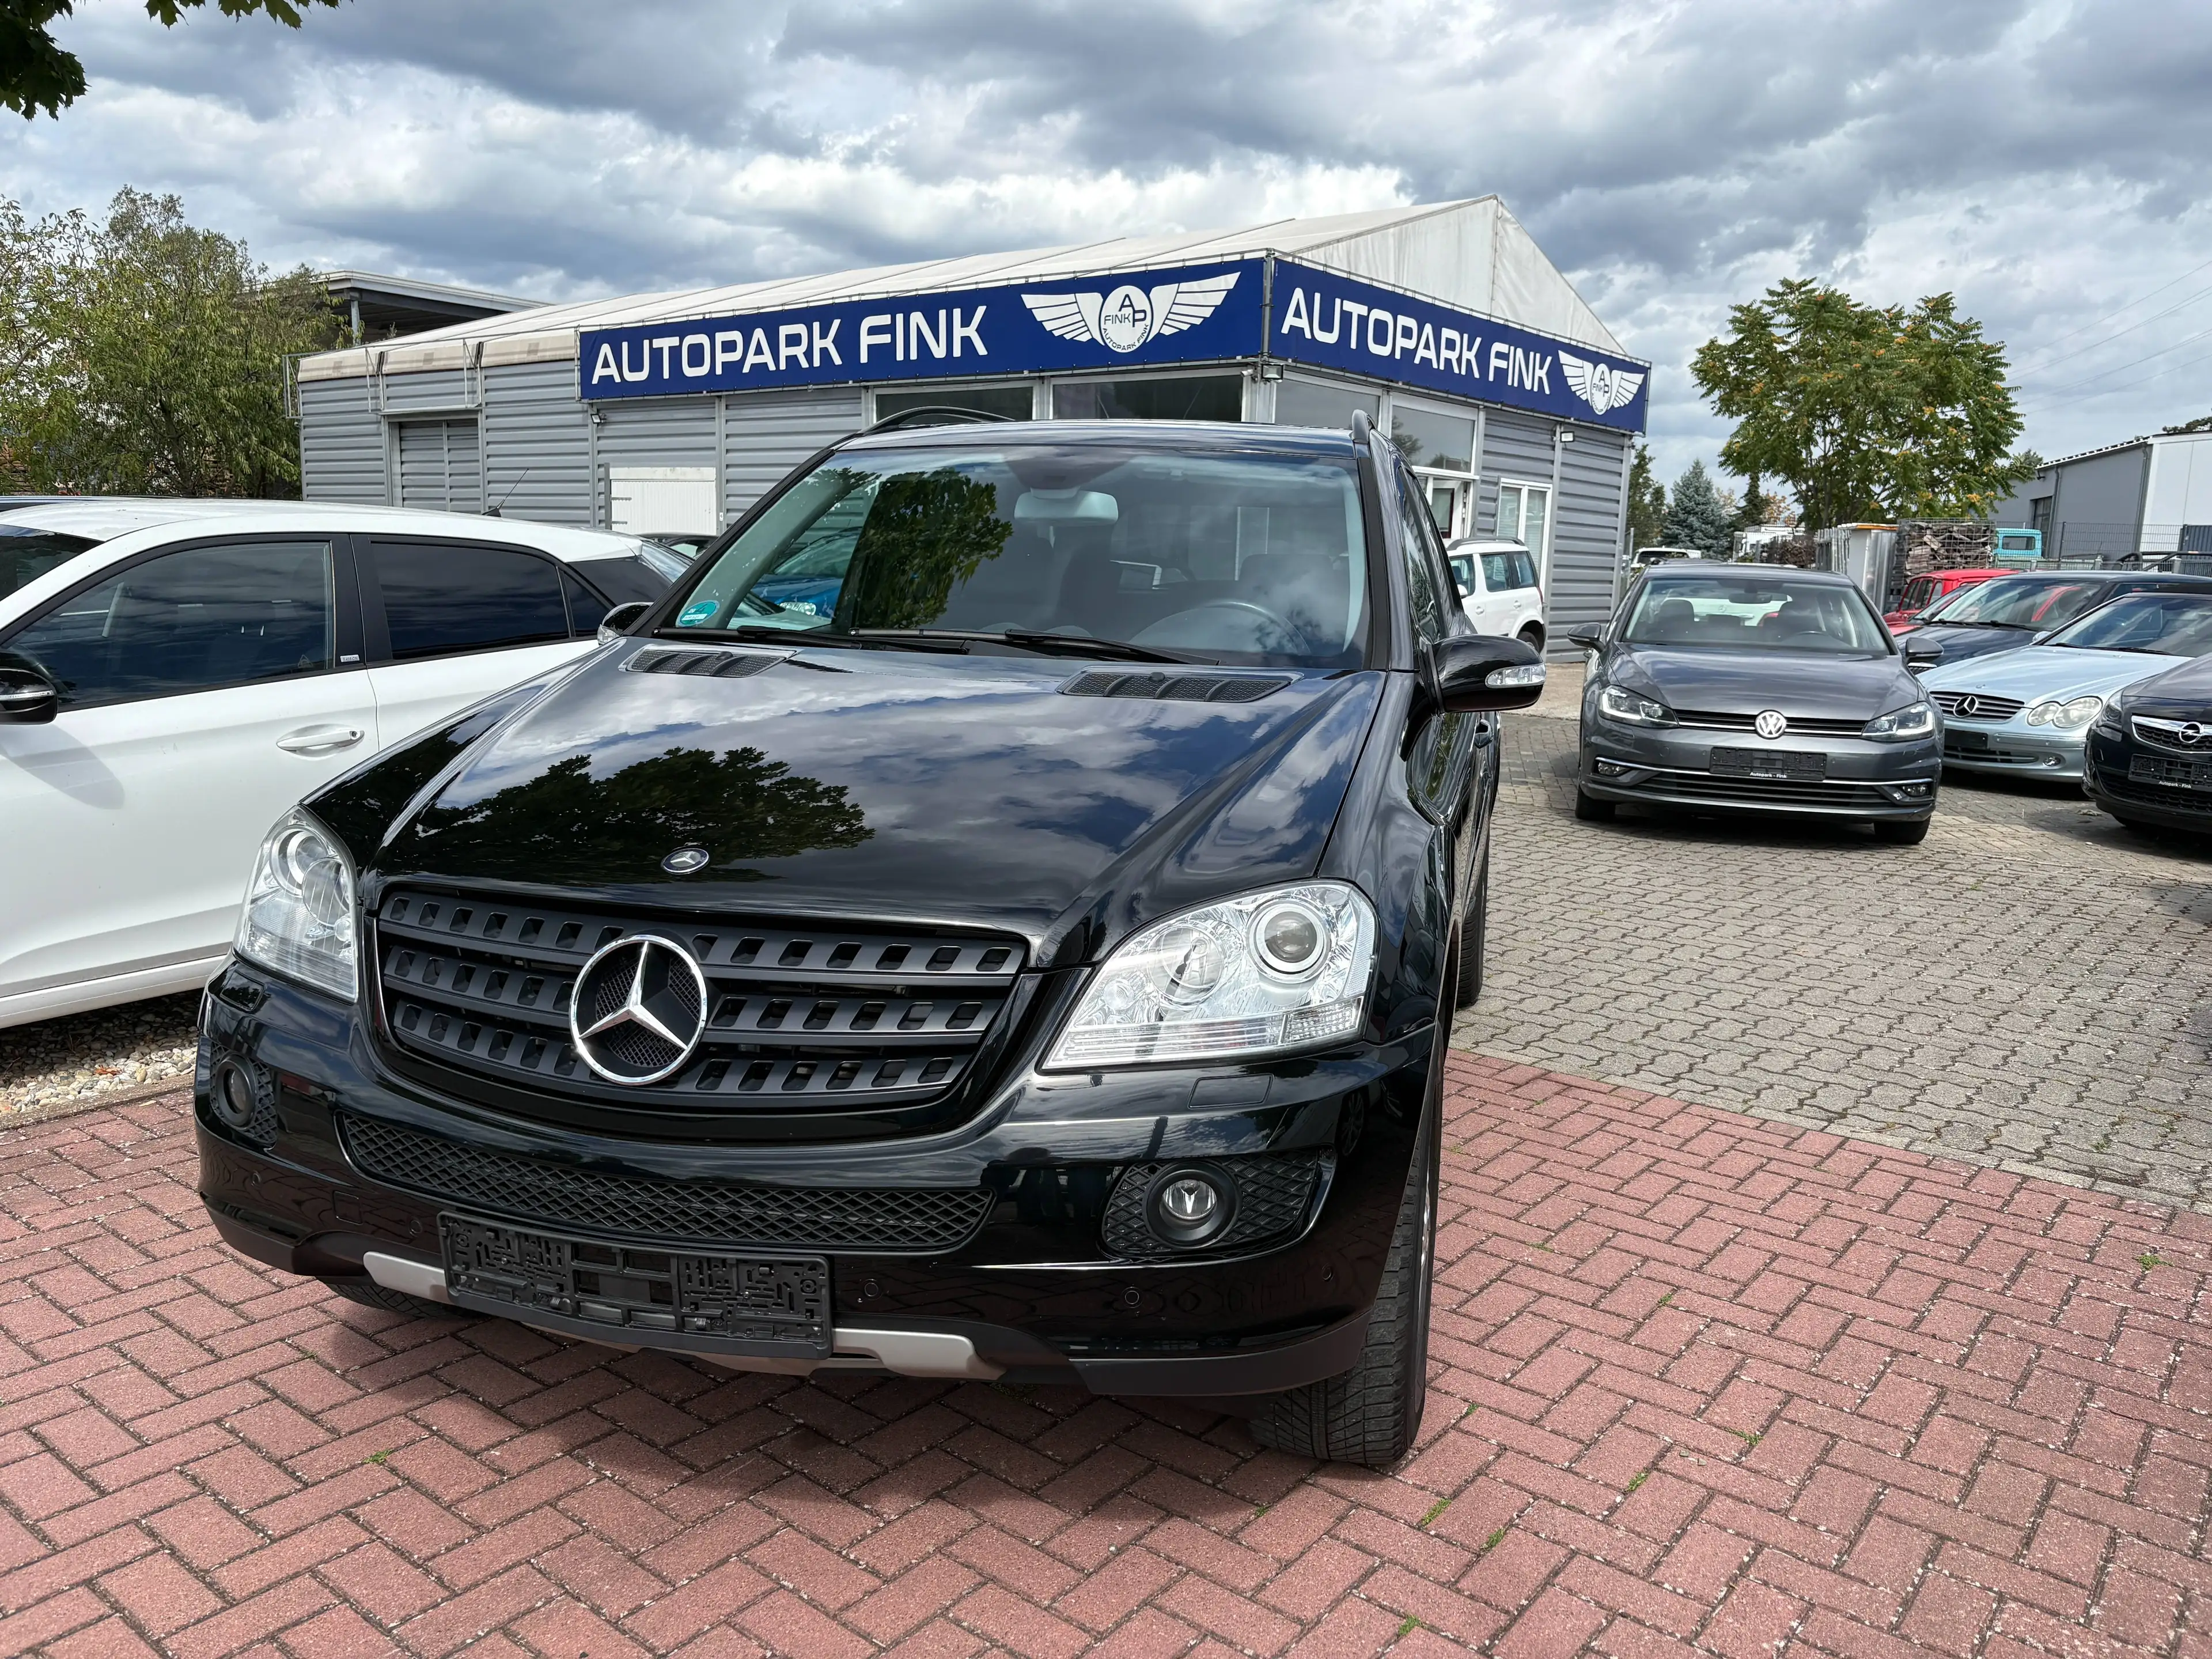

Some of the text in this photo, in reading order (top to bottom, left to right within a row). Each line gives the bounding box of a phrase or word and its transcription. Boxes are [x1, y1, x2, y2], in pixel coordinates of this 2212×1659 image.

[592, 305, 988, 385] AUTOPARK FINK
[1103, 323, 1149, 351] AUTOPARK FINK
[1104, 313, 1131, 325] FINK
[1281, 287, 1552, 395] AUTOPARK FINK
